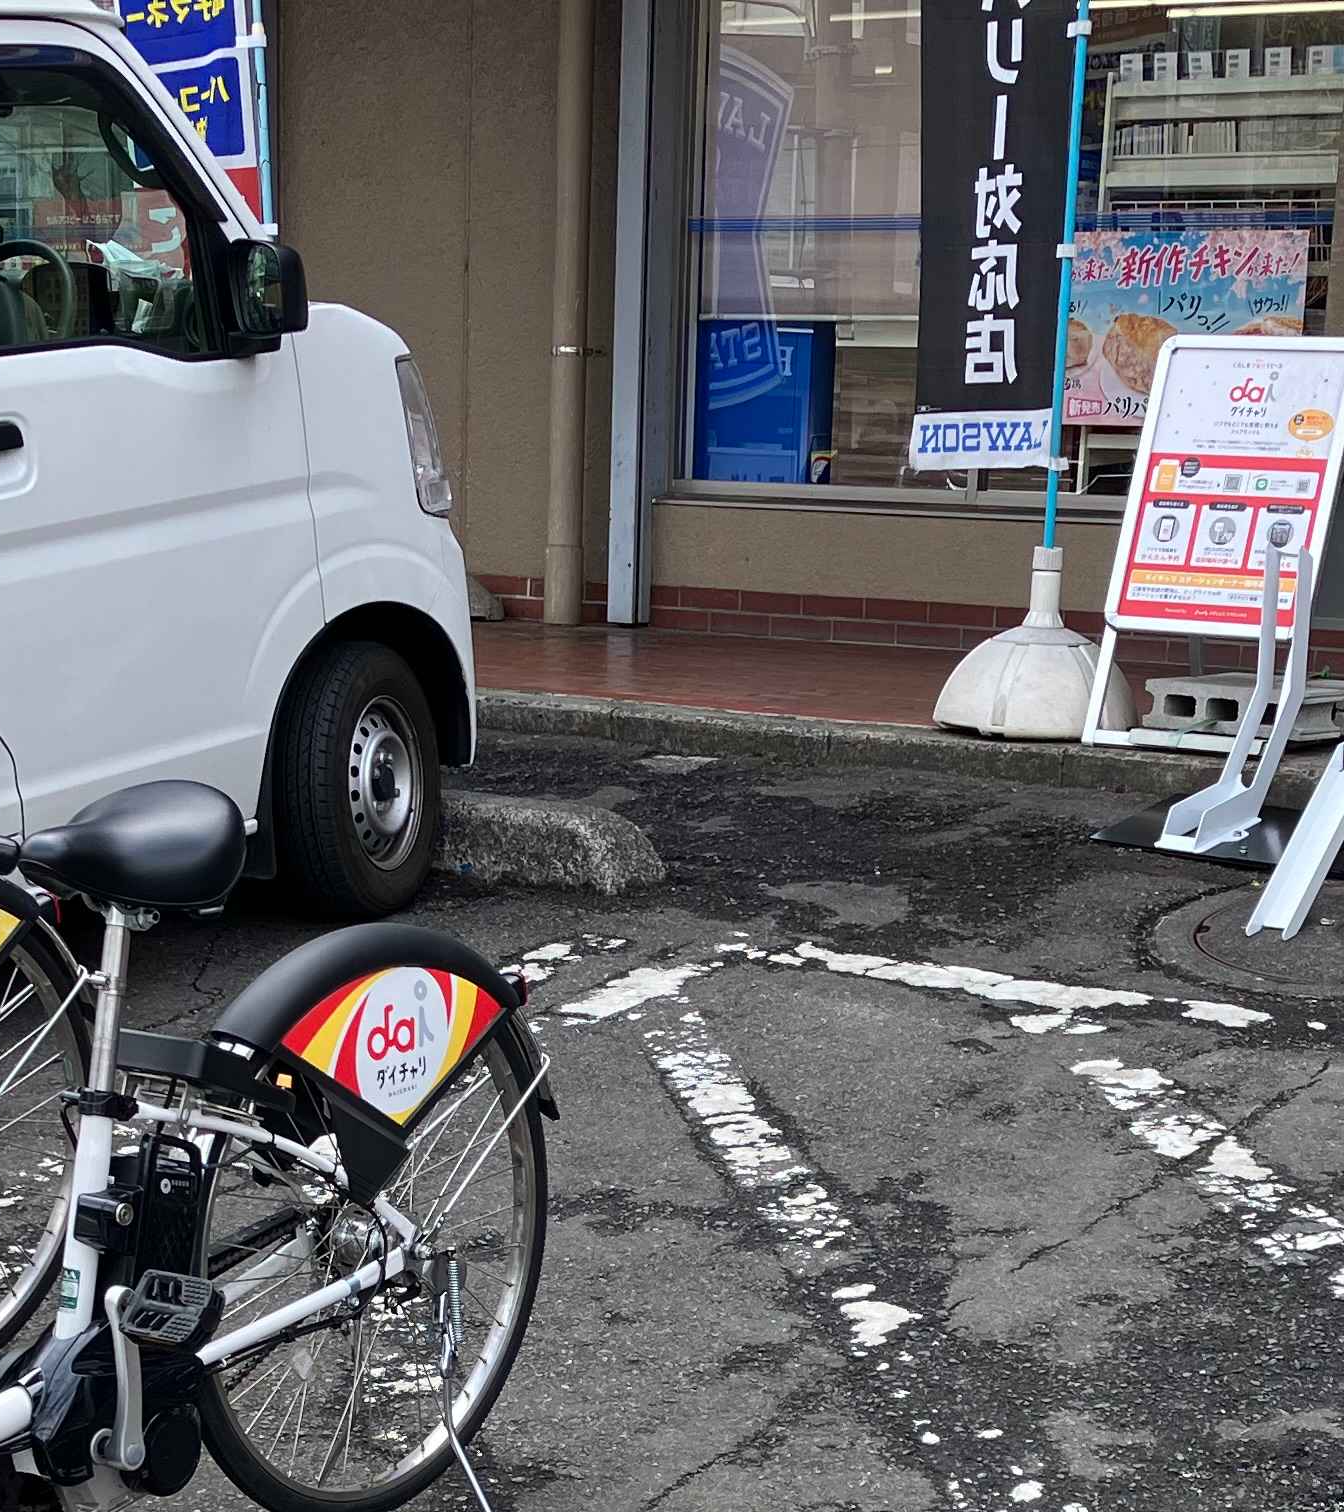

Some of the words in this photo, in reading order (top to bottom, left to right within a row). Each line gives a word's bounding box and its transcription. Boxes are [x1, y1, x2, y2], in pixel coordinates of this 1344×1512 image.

[1229, 371, 1279, 404] dai
[367, 979, 435, 1061] dai
[376, 1056, 427, 1090] ダイチャリ
